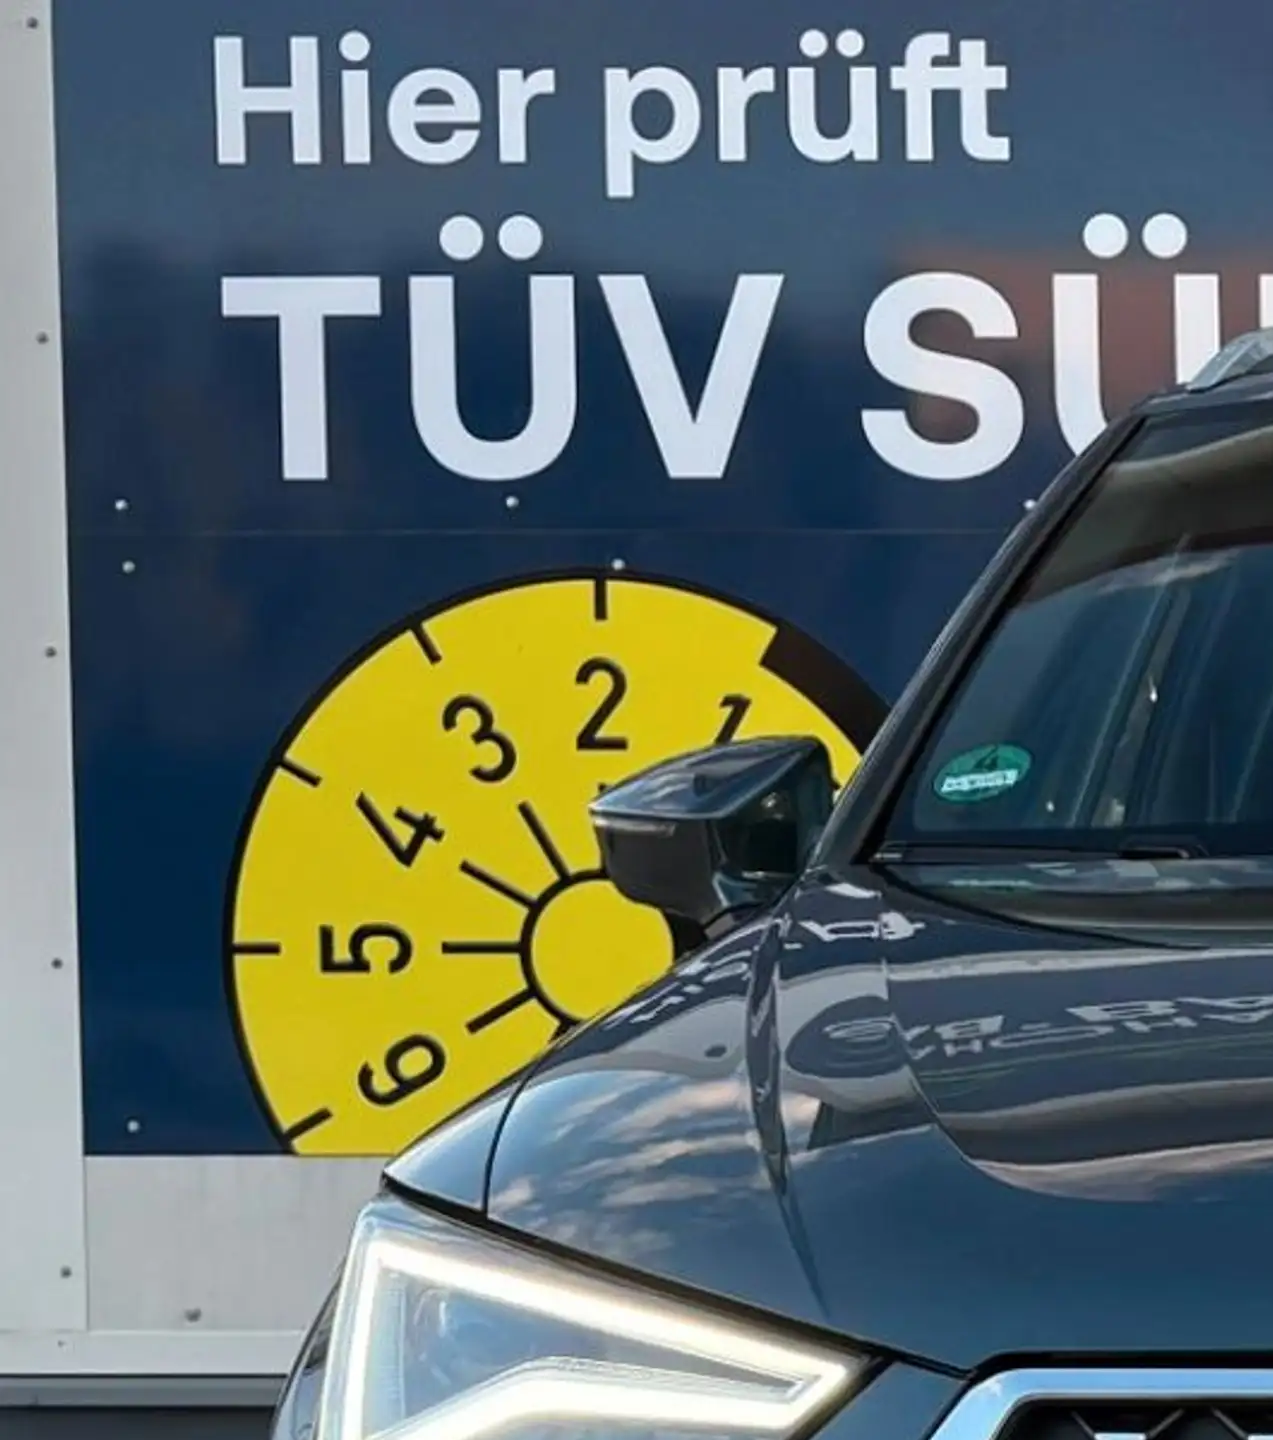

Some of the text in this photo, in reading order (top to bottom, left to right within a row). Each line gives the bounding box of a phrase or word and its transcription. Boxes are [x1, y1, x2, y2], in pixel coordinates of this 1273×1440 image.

[214, 29, 1011, 198] Hier prüft
[221, 214, 785, 481] TÜV
[442, 694, 518, 783] 3
[575, 656, 629, 752] 2
[356, 791, 446, 868] 4
[319, 922, 413, 975] 5
